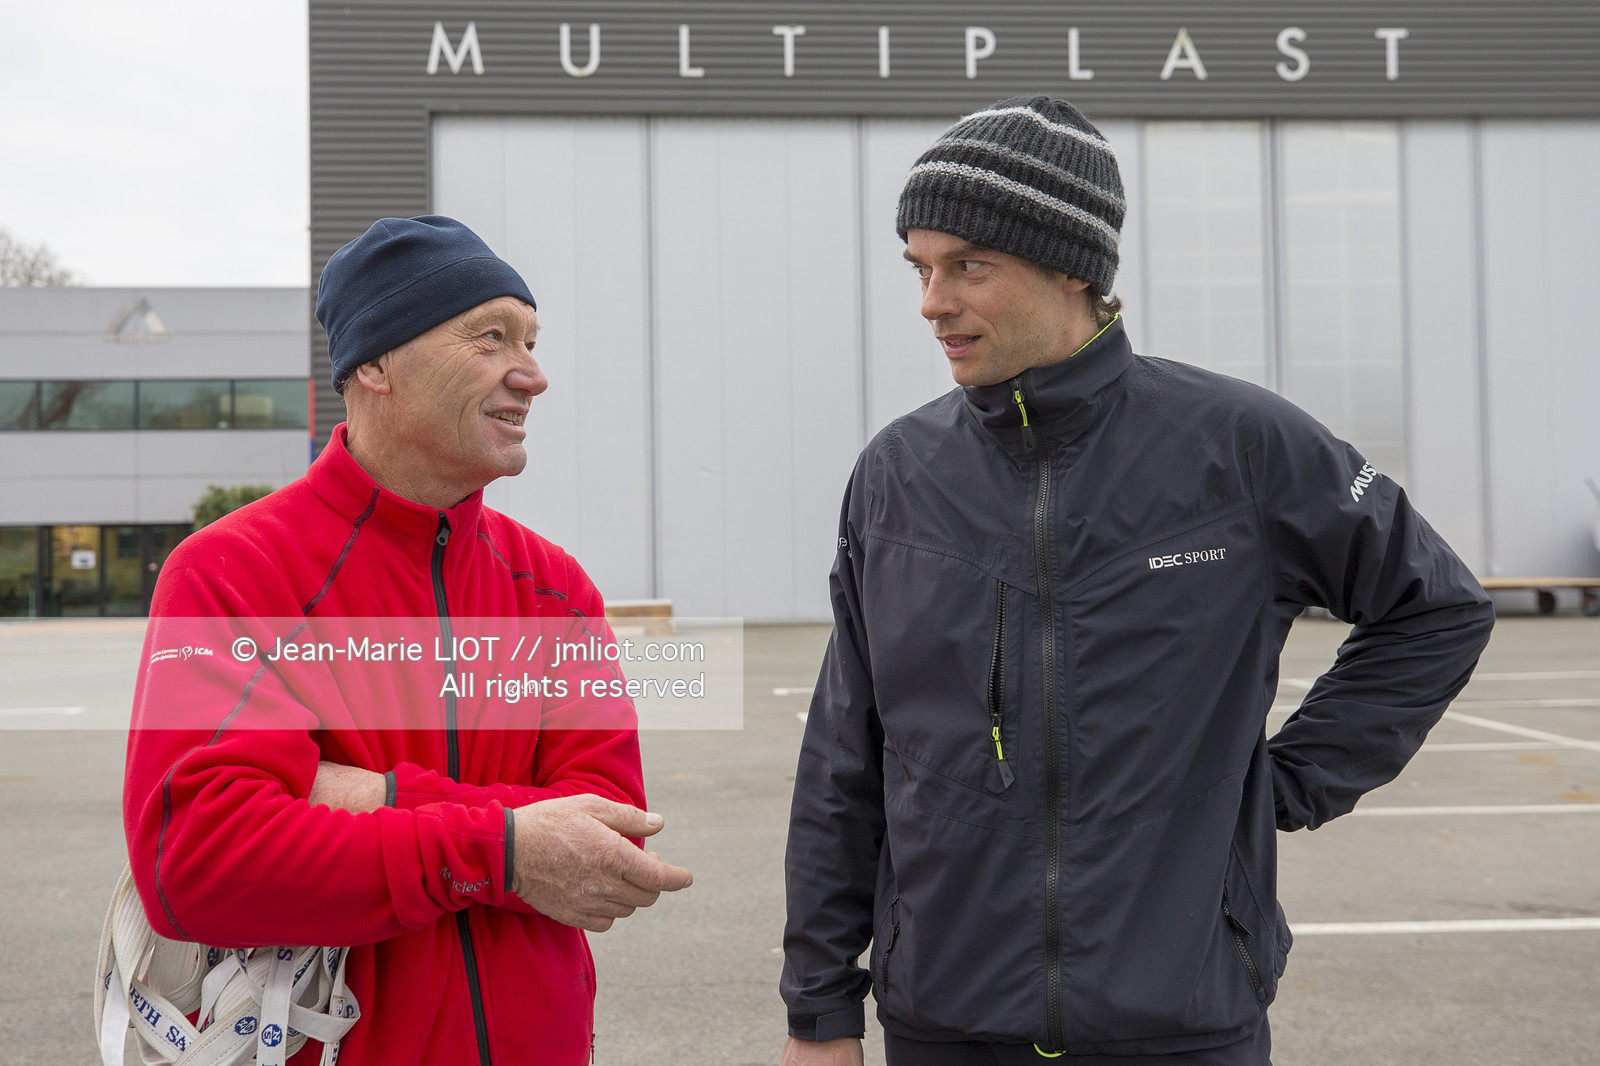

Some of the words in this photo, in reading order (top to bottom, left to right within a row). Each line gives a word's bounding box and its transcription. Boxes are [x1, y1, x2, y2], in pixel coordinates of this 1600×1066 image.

[426, 20, 1410, 81] MULTIPLAST
[1350, 462, 1377, 503] MUS
[1148, 553, 1183, 570] IDEC
[1184, 547, 1227, 565] SPORT
[194, 647, 214, 656] ICM
[129, 981, 162, 1028] RTH
